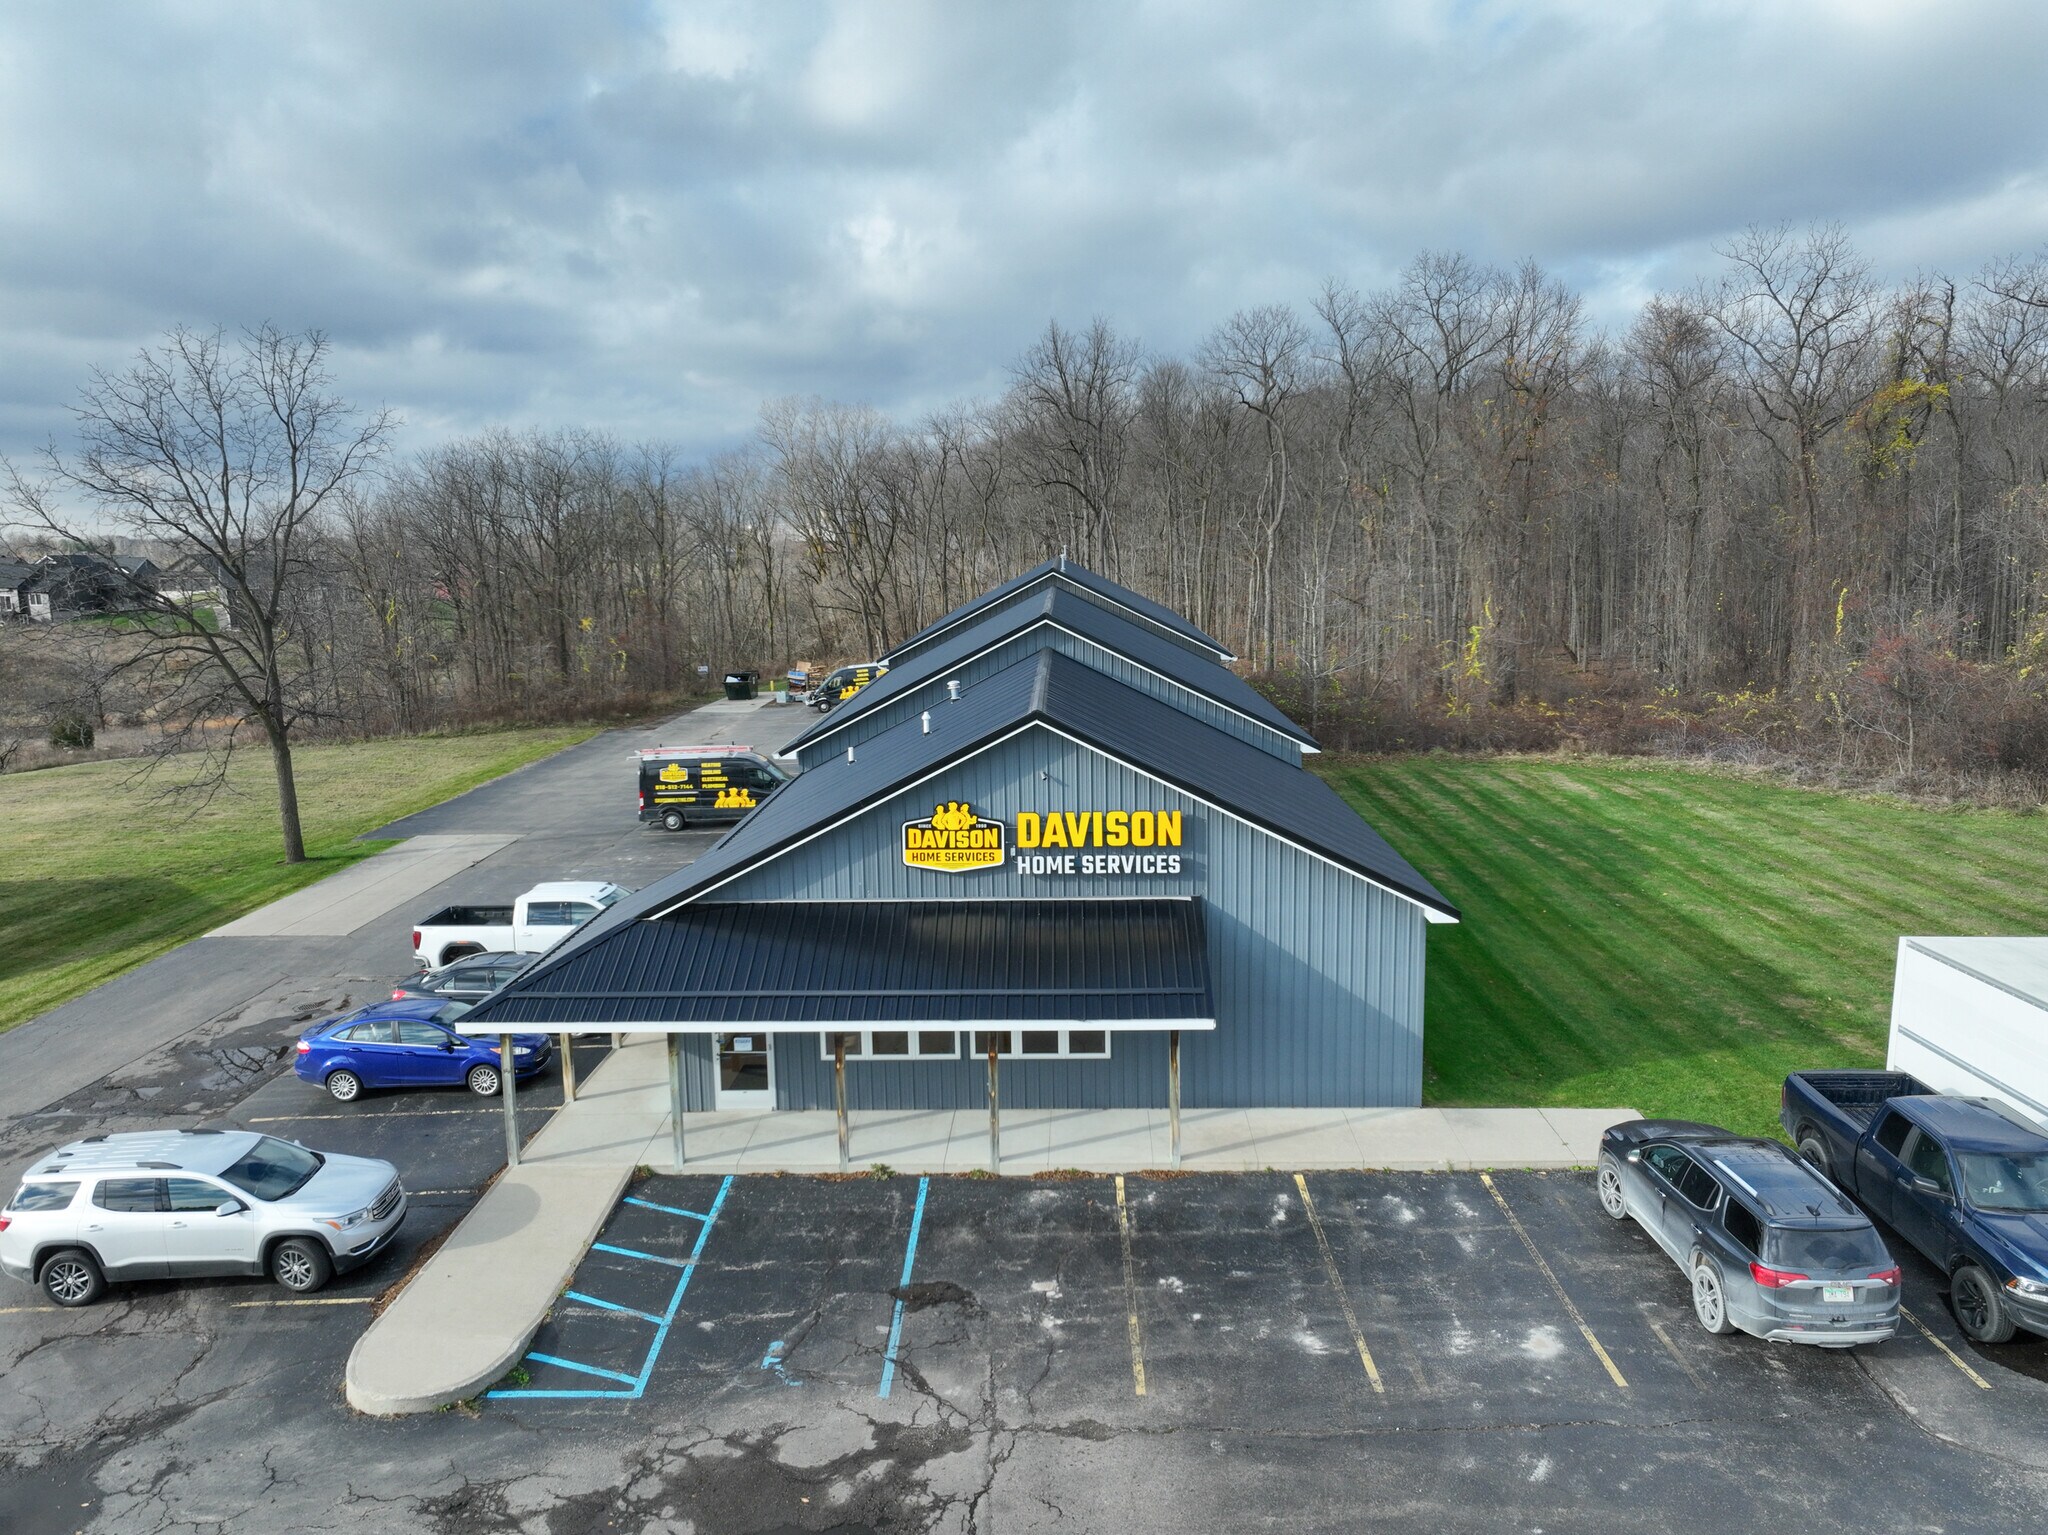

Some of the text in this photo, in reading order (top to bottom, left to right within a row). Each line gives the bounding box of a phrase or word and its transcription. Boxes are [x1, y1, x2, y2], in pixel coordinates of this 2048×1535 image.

[908, 828, 998, 848] DAVISON
[1017, 810, 1182, 848] DAVISON
[912, 852, 995, 862] HOME SERVICES
[1017, 855, 1181, 875] HOME SERVICES
